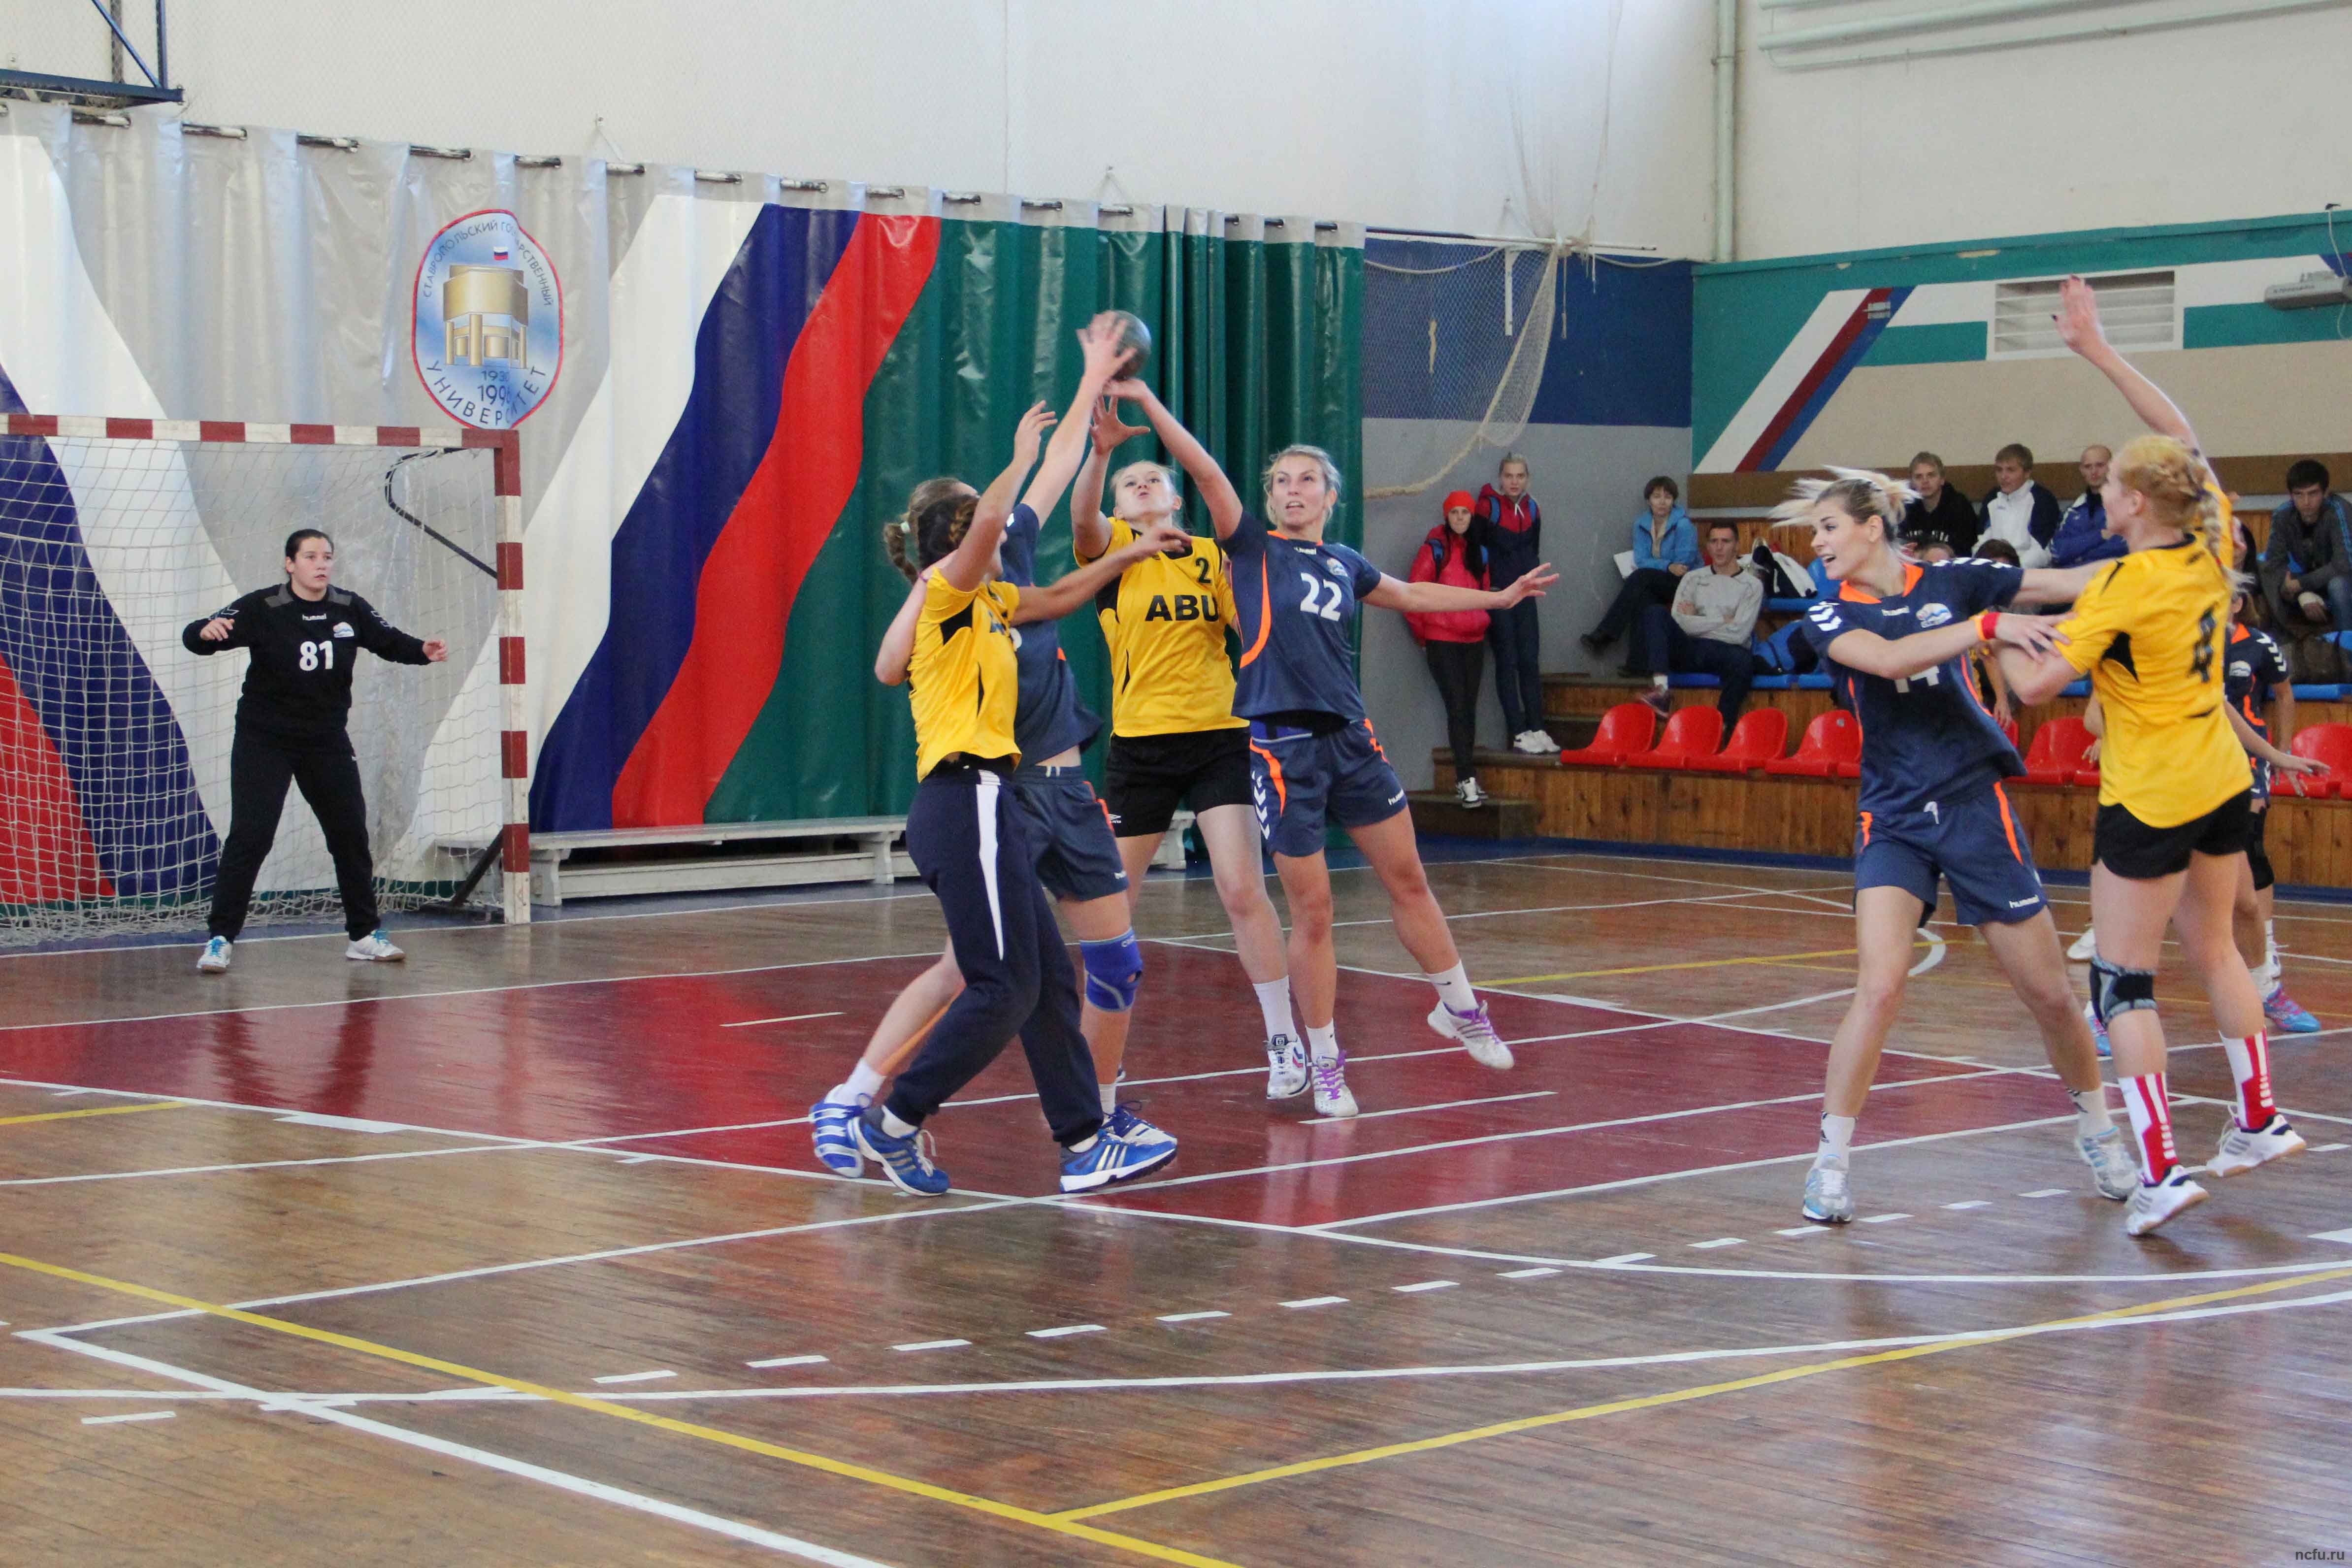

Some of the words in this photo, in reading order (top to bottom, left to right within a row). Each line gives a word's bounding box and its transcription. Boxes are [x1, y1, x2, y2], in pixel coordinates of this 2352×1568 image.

[423, 219, 498, 298] СТАВРОПОЛЬСКИЙ
[1195, 557, 1211, 584] 2
[1145, 594, 1219, 622] ABU
[1300, 572, 1342, 621] 22
[299, 640, 333, 671] 81
